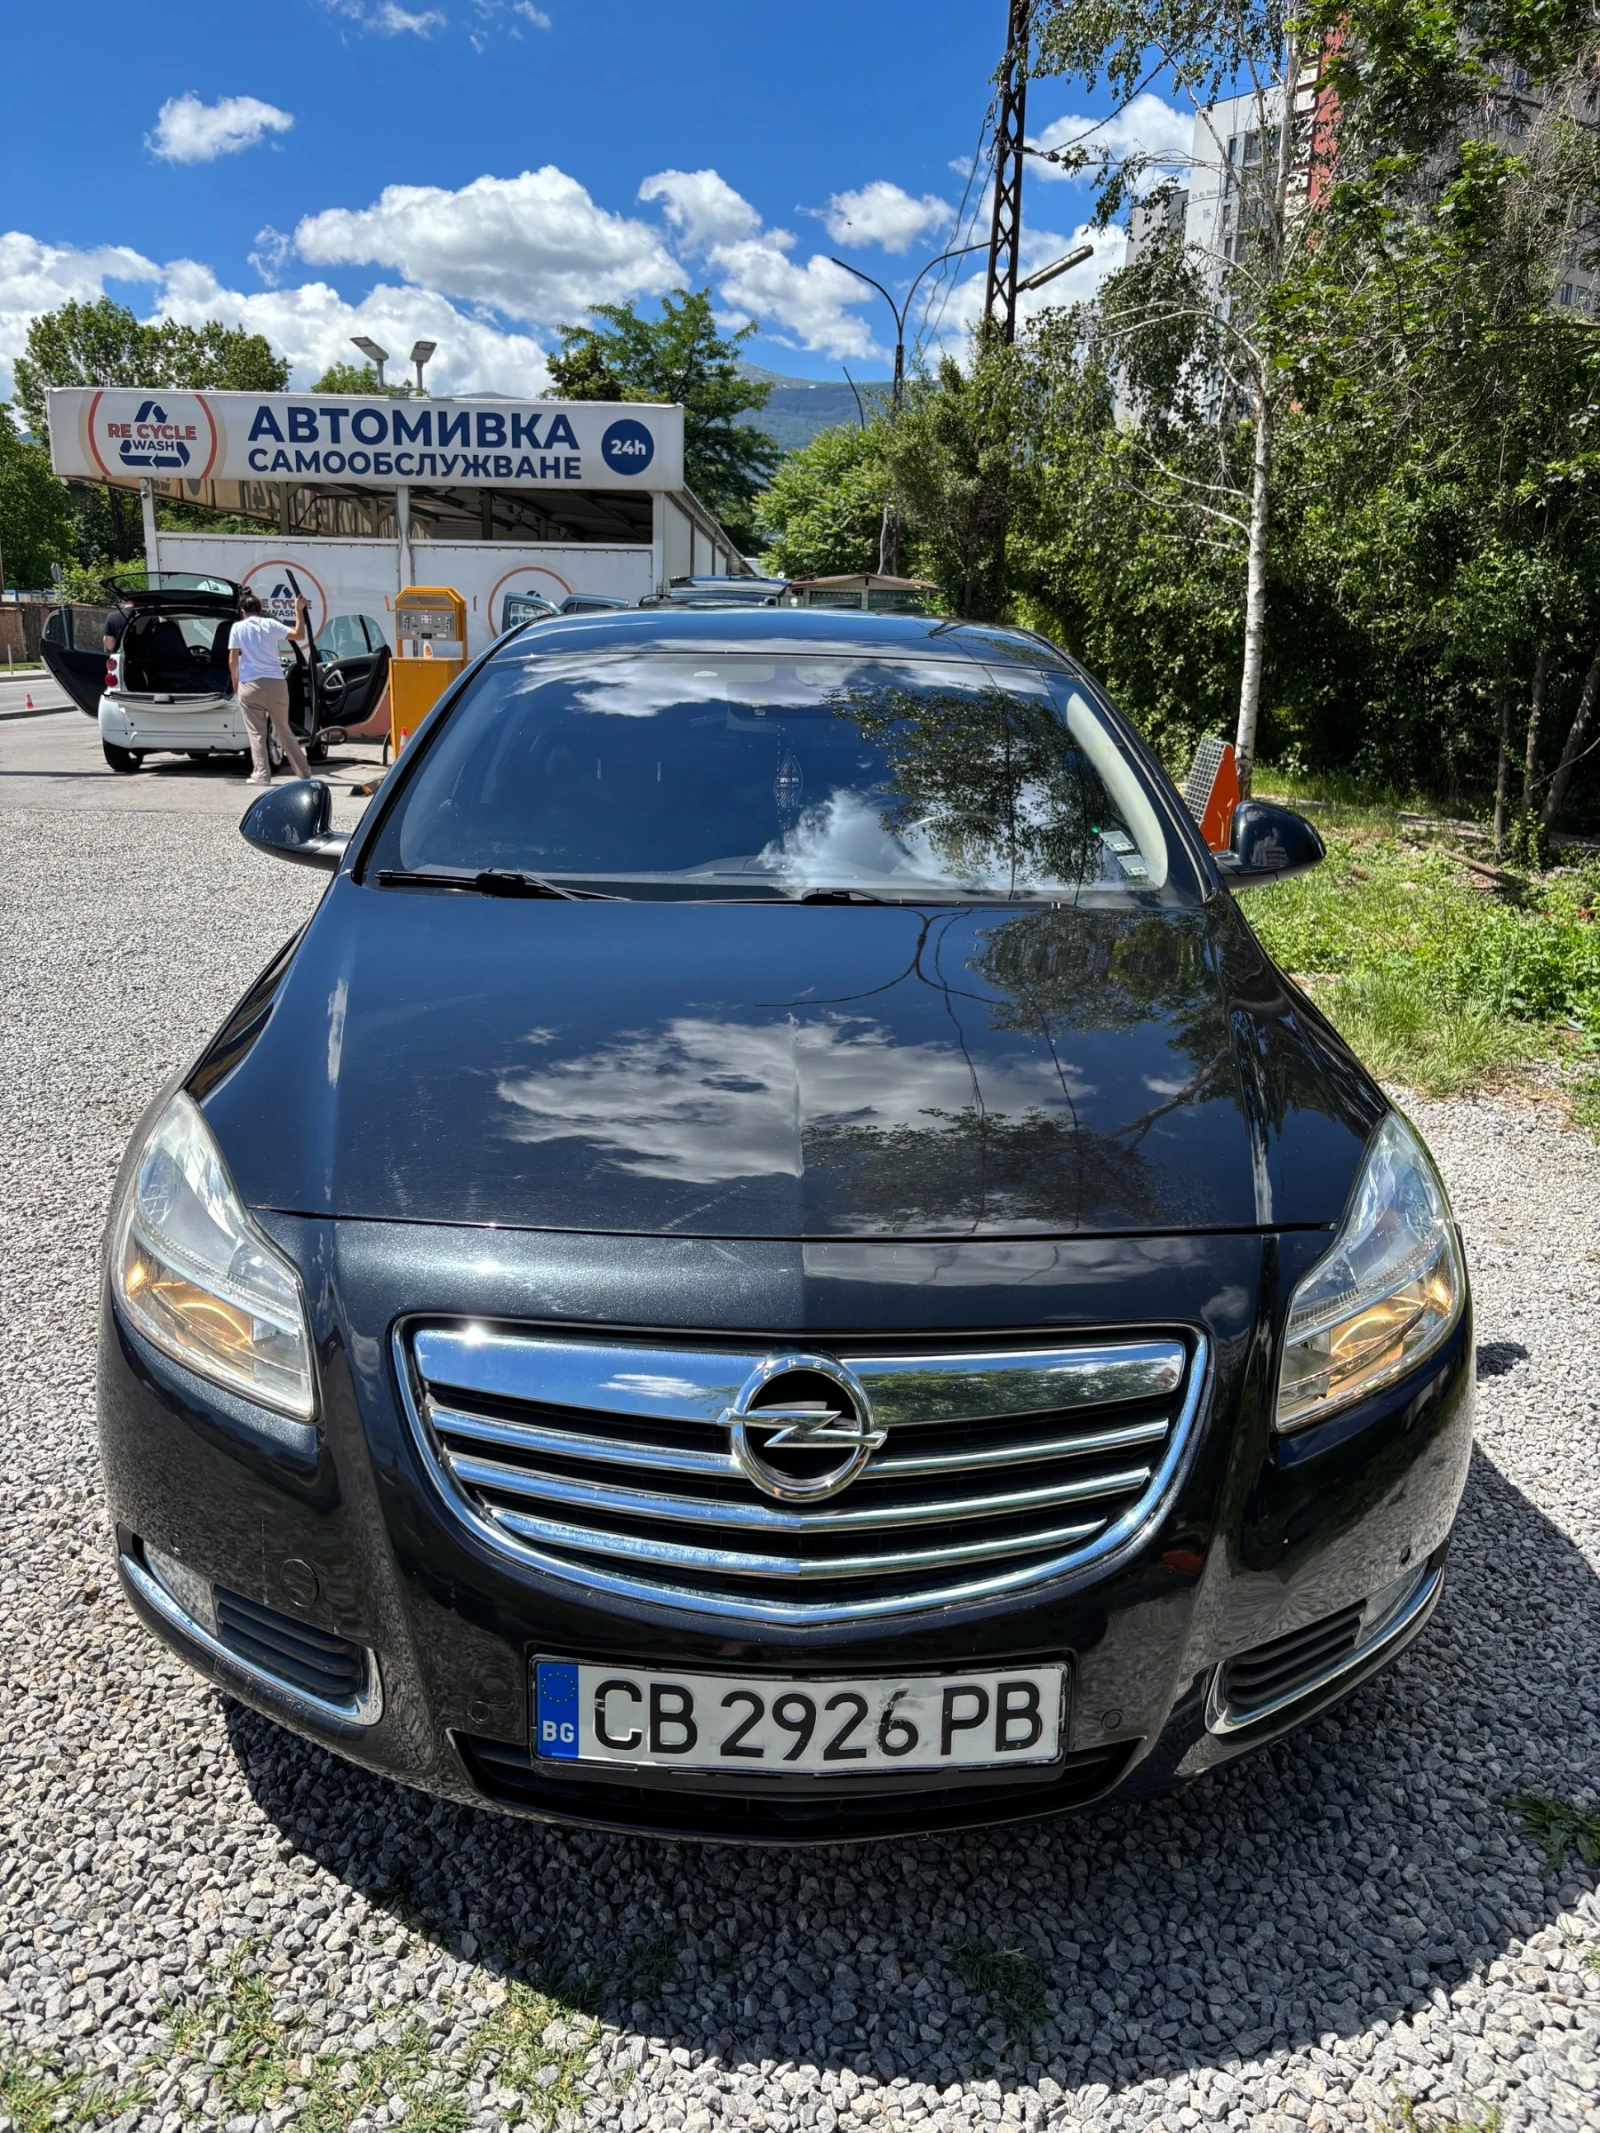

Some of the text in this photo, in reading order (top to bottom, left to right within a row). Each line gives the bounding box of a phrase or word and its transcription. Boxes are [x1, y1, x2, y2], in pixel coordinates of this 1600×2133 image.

[107, 423, 197, 440] RE CYCLE
[247, 406, 581, 450] АВТОМИВКА
[132, 439, 175, 451] WASH
[610, 439, 647, 456] 24h
[248, 448, 582, 480] САМООБСЛУЖВАНЕ
[542, 1720, 575, 1743] BG
[720, 1688, 919, 1761] 2926
